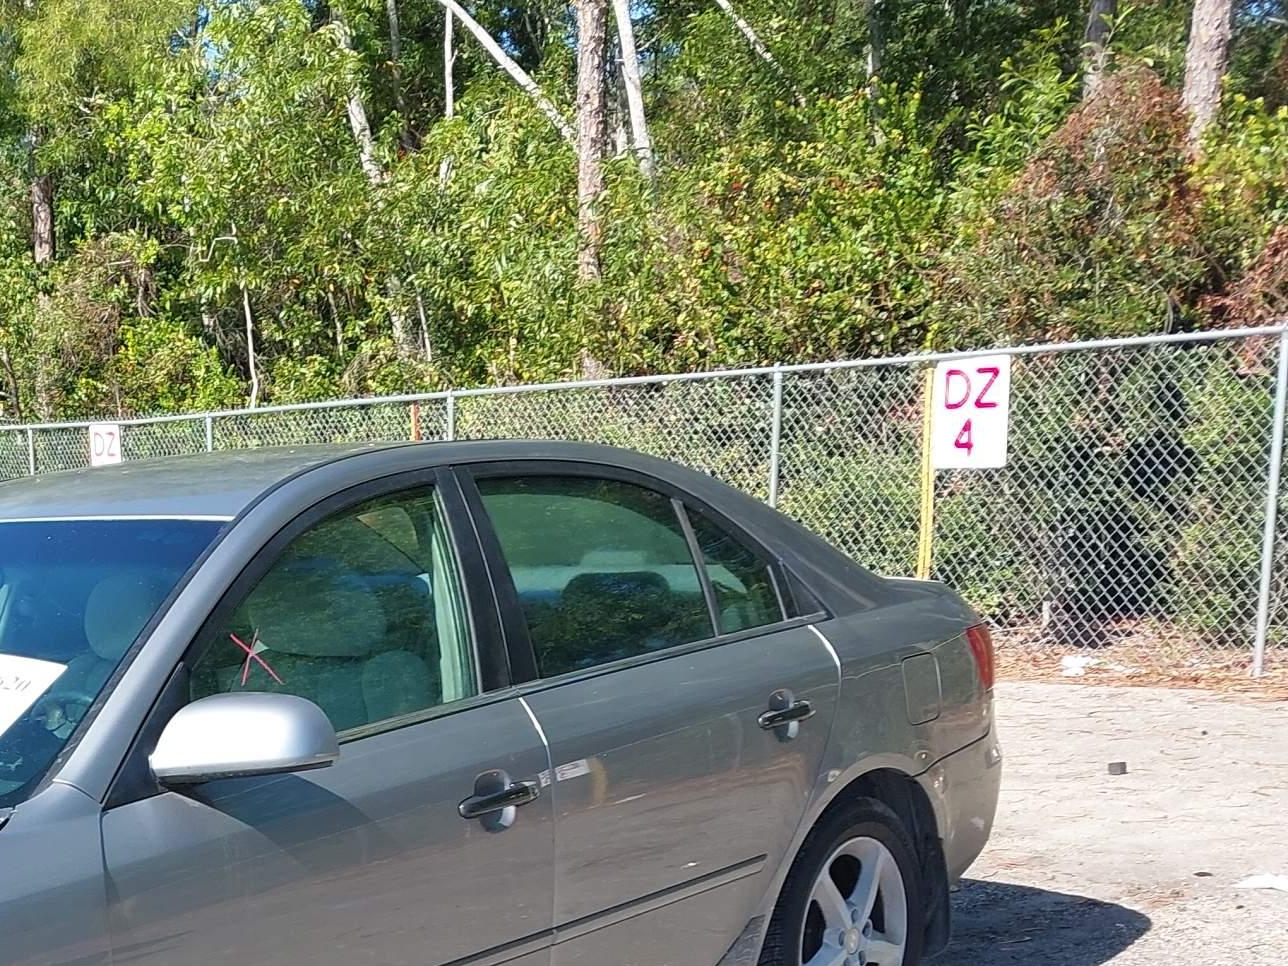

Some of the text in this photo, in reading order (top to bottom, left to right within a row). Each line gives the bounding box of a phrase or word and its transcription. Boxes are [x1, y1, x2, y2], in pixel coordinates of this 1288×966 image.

[944, 367, 1000, 409] DZ
[94, 431, 117, 457] DZ
[954, 418, 974, 456] 4
